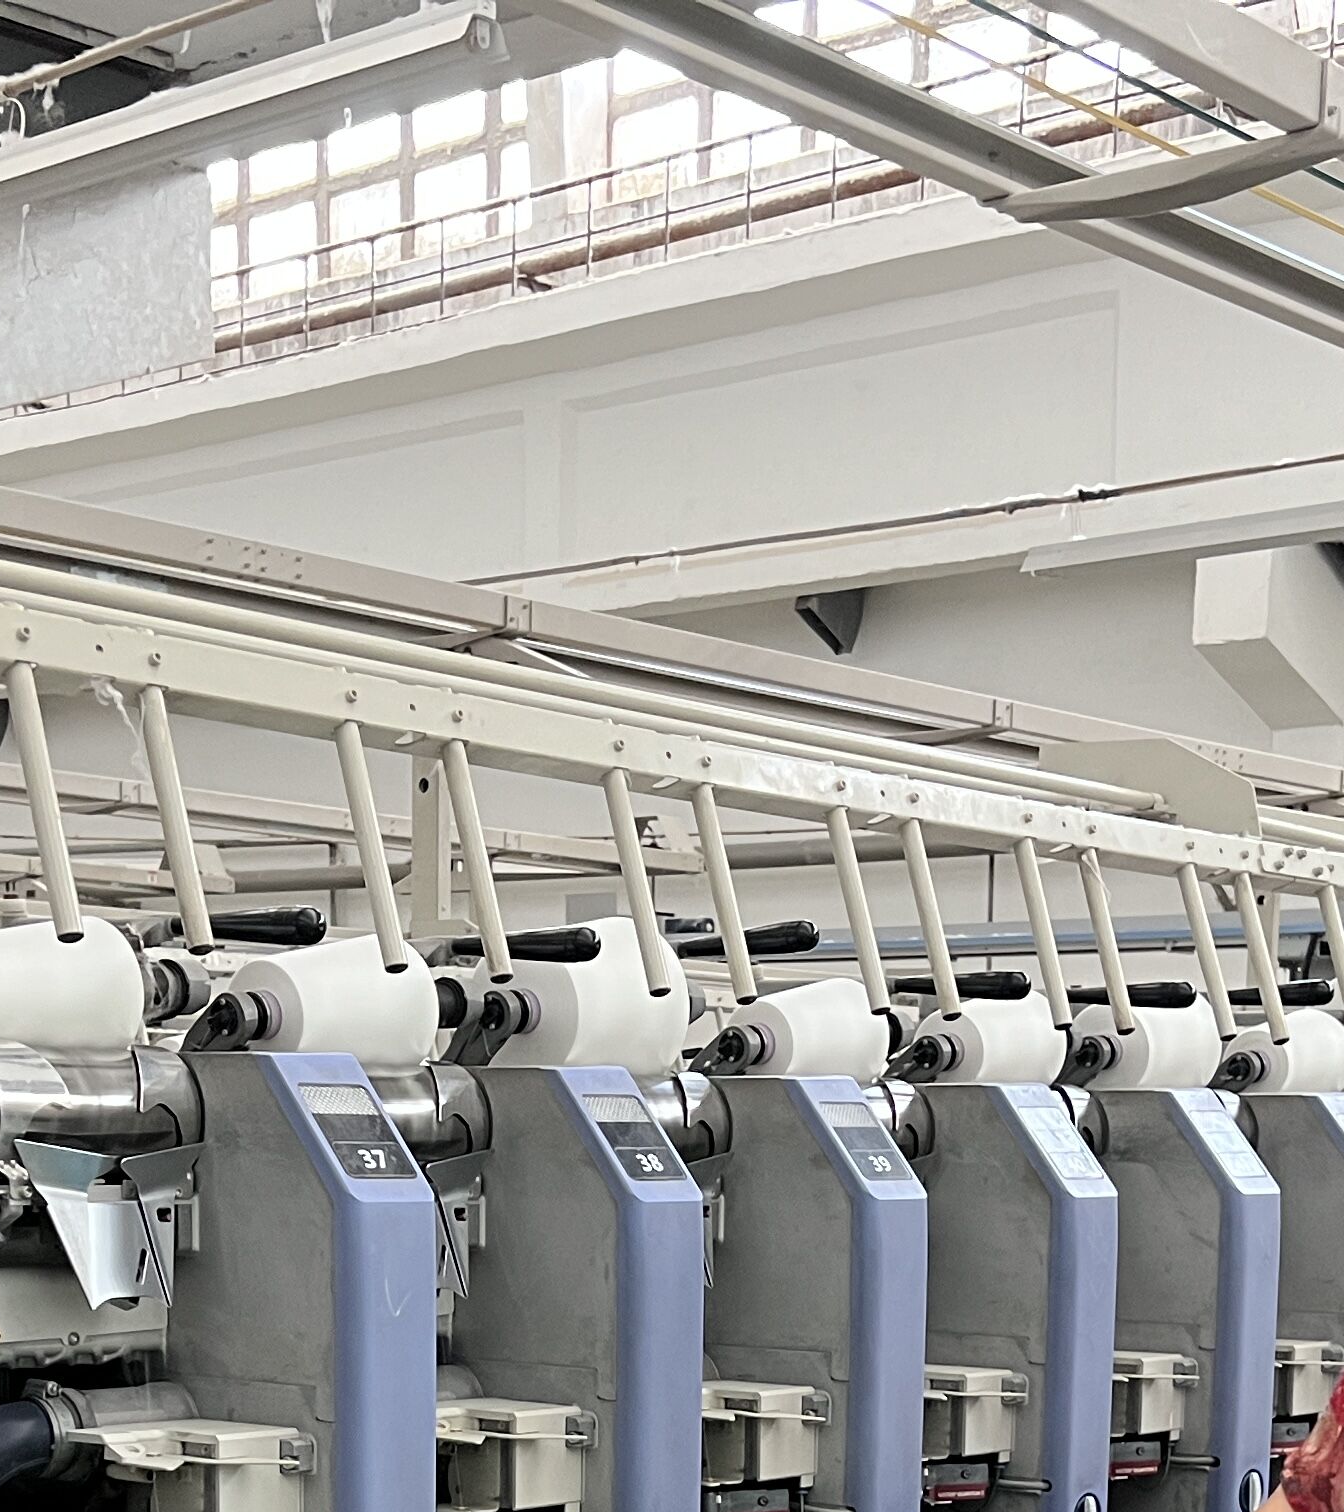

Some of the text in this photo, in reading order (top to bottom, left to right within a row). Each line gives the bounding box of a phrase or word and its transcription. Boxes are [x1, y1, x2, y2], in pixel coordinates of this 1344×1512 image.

[357, 1148, 387, 1170] 37
[635, 1153, 665, 1173] 38
[867, 1155, 892, 1173] 39
